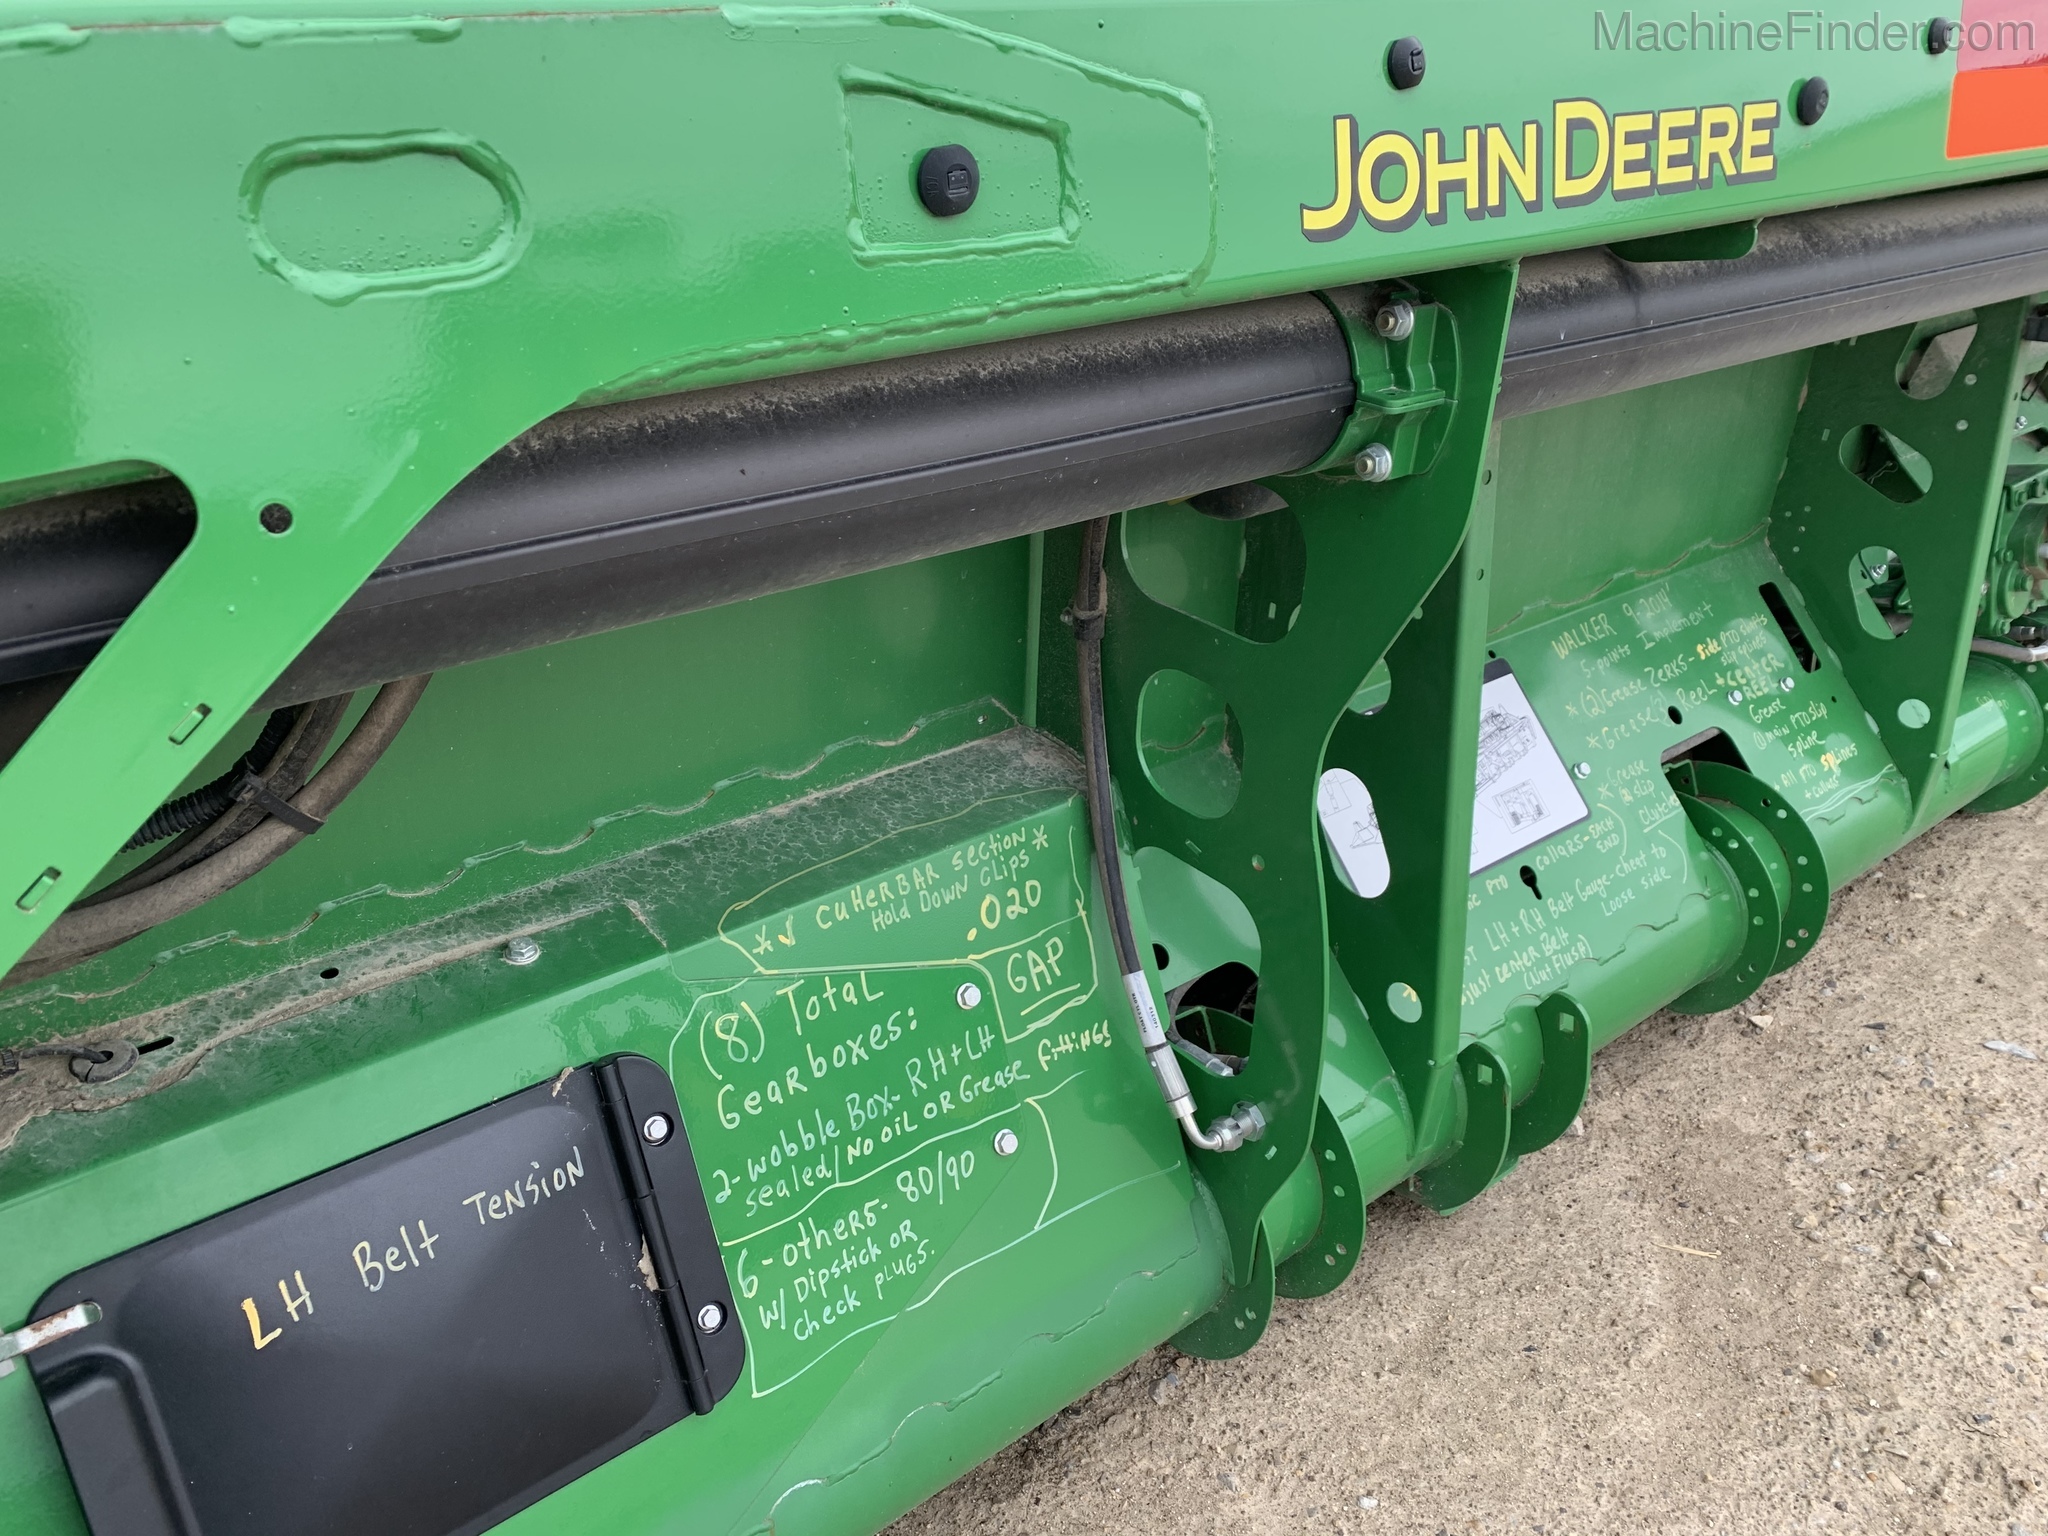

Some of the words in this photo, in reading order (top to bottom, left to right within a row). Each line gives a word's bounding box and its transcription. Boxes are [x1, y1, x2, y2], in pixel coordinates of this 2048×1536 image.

[1300, 115, 1543, 242] JOHN
[1552, 97, 1781, 208] DEERE
[1552, 613, 1617, 660] WALKER
[1596, 833, 1620, 853] END
[967, 879, 1042, 941] .020
[1485, 875, 1508, 895] PTO
[1006, 936, 1065, 995] GAP
[699, 1001, 765, 1080] (8)
[959, 1059, 1030, 1104] Grease
[896, 1149, 975, 1205] 80/90
[240, 1270, 314, 1351] LH
[352, 1219, 440, 1293] Belt
